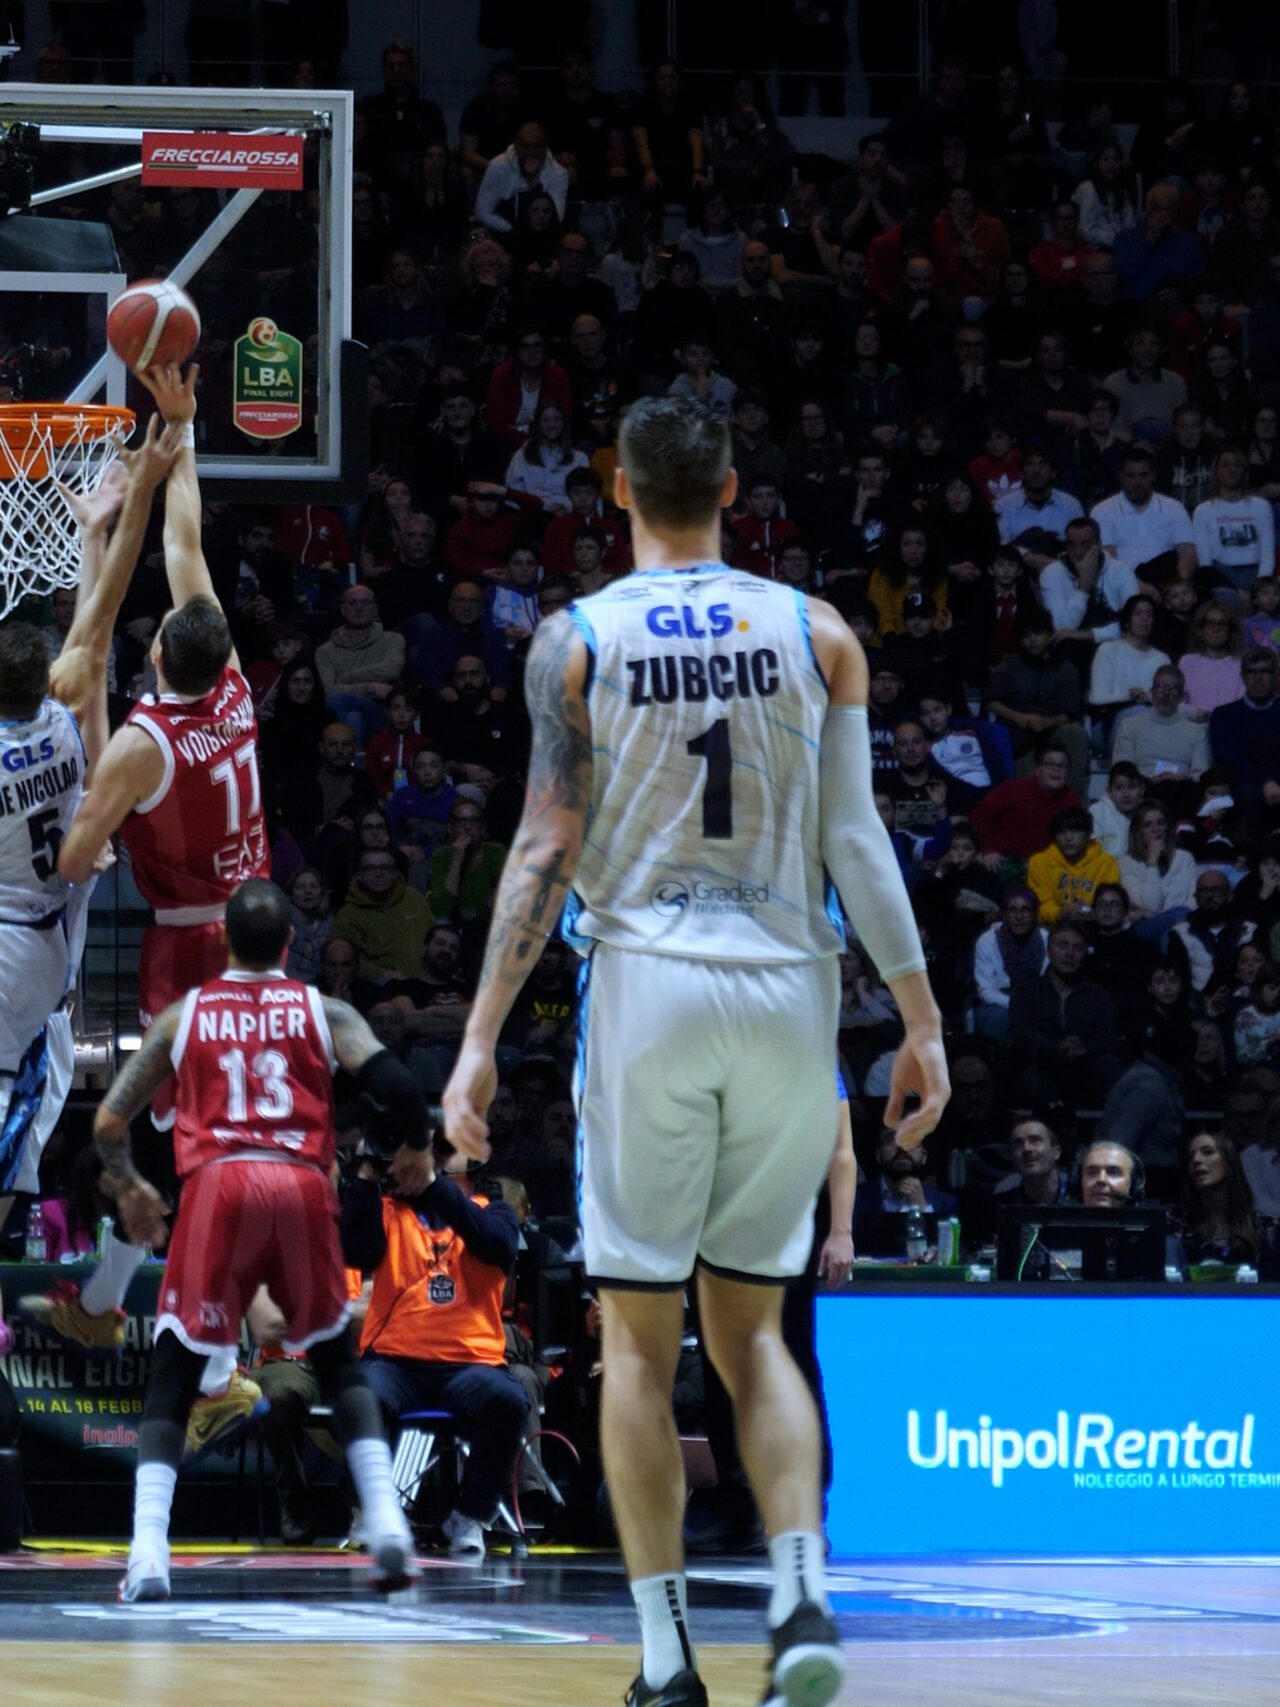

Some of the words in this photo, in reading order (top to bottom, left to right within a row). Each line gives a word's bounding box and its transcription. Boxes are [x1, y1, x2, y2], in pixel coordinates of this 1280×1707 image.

[150, 148, 299, 166] FRECCIAROSSA
[243, 366, 294, 387] LBA
[243, 389, 268, 397] FINAL
[270, 390, 295, 398] EIGHT
[14, 756, 79, 812] NICOLAO
[686, 718, 734, 840] 1
[26, 807, 65, 883] 5
[693, 880, 770, 903] Graded
[259, 988, 304, 1005] AON
[197, 1007, 307, 1043] NAPIER
[218, 1047, 294, 1123] 13
[27, 1400, 45, 1414] 14
[50, 1400, 72, 1414] AL
[77, 1400, 94, 1414] 18
[99, 1399, 144, 1414] FEBB
[82, 1425, 139, 1445] inalp
[907, 1409, 1256, 1488] UnipolRental
[1074, 1473, 1154, 1489] NOLEGGIO
[1158, 1473, 1169, 1489] A
[1172, 1473, 1226, 1489] LUNGO
